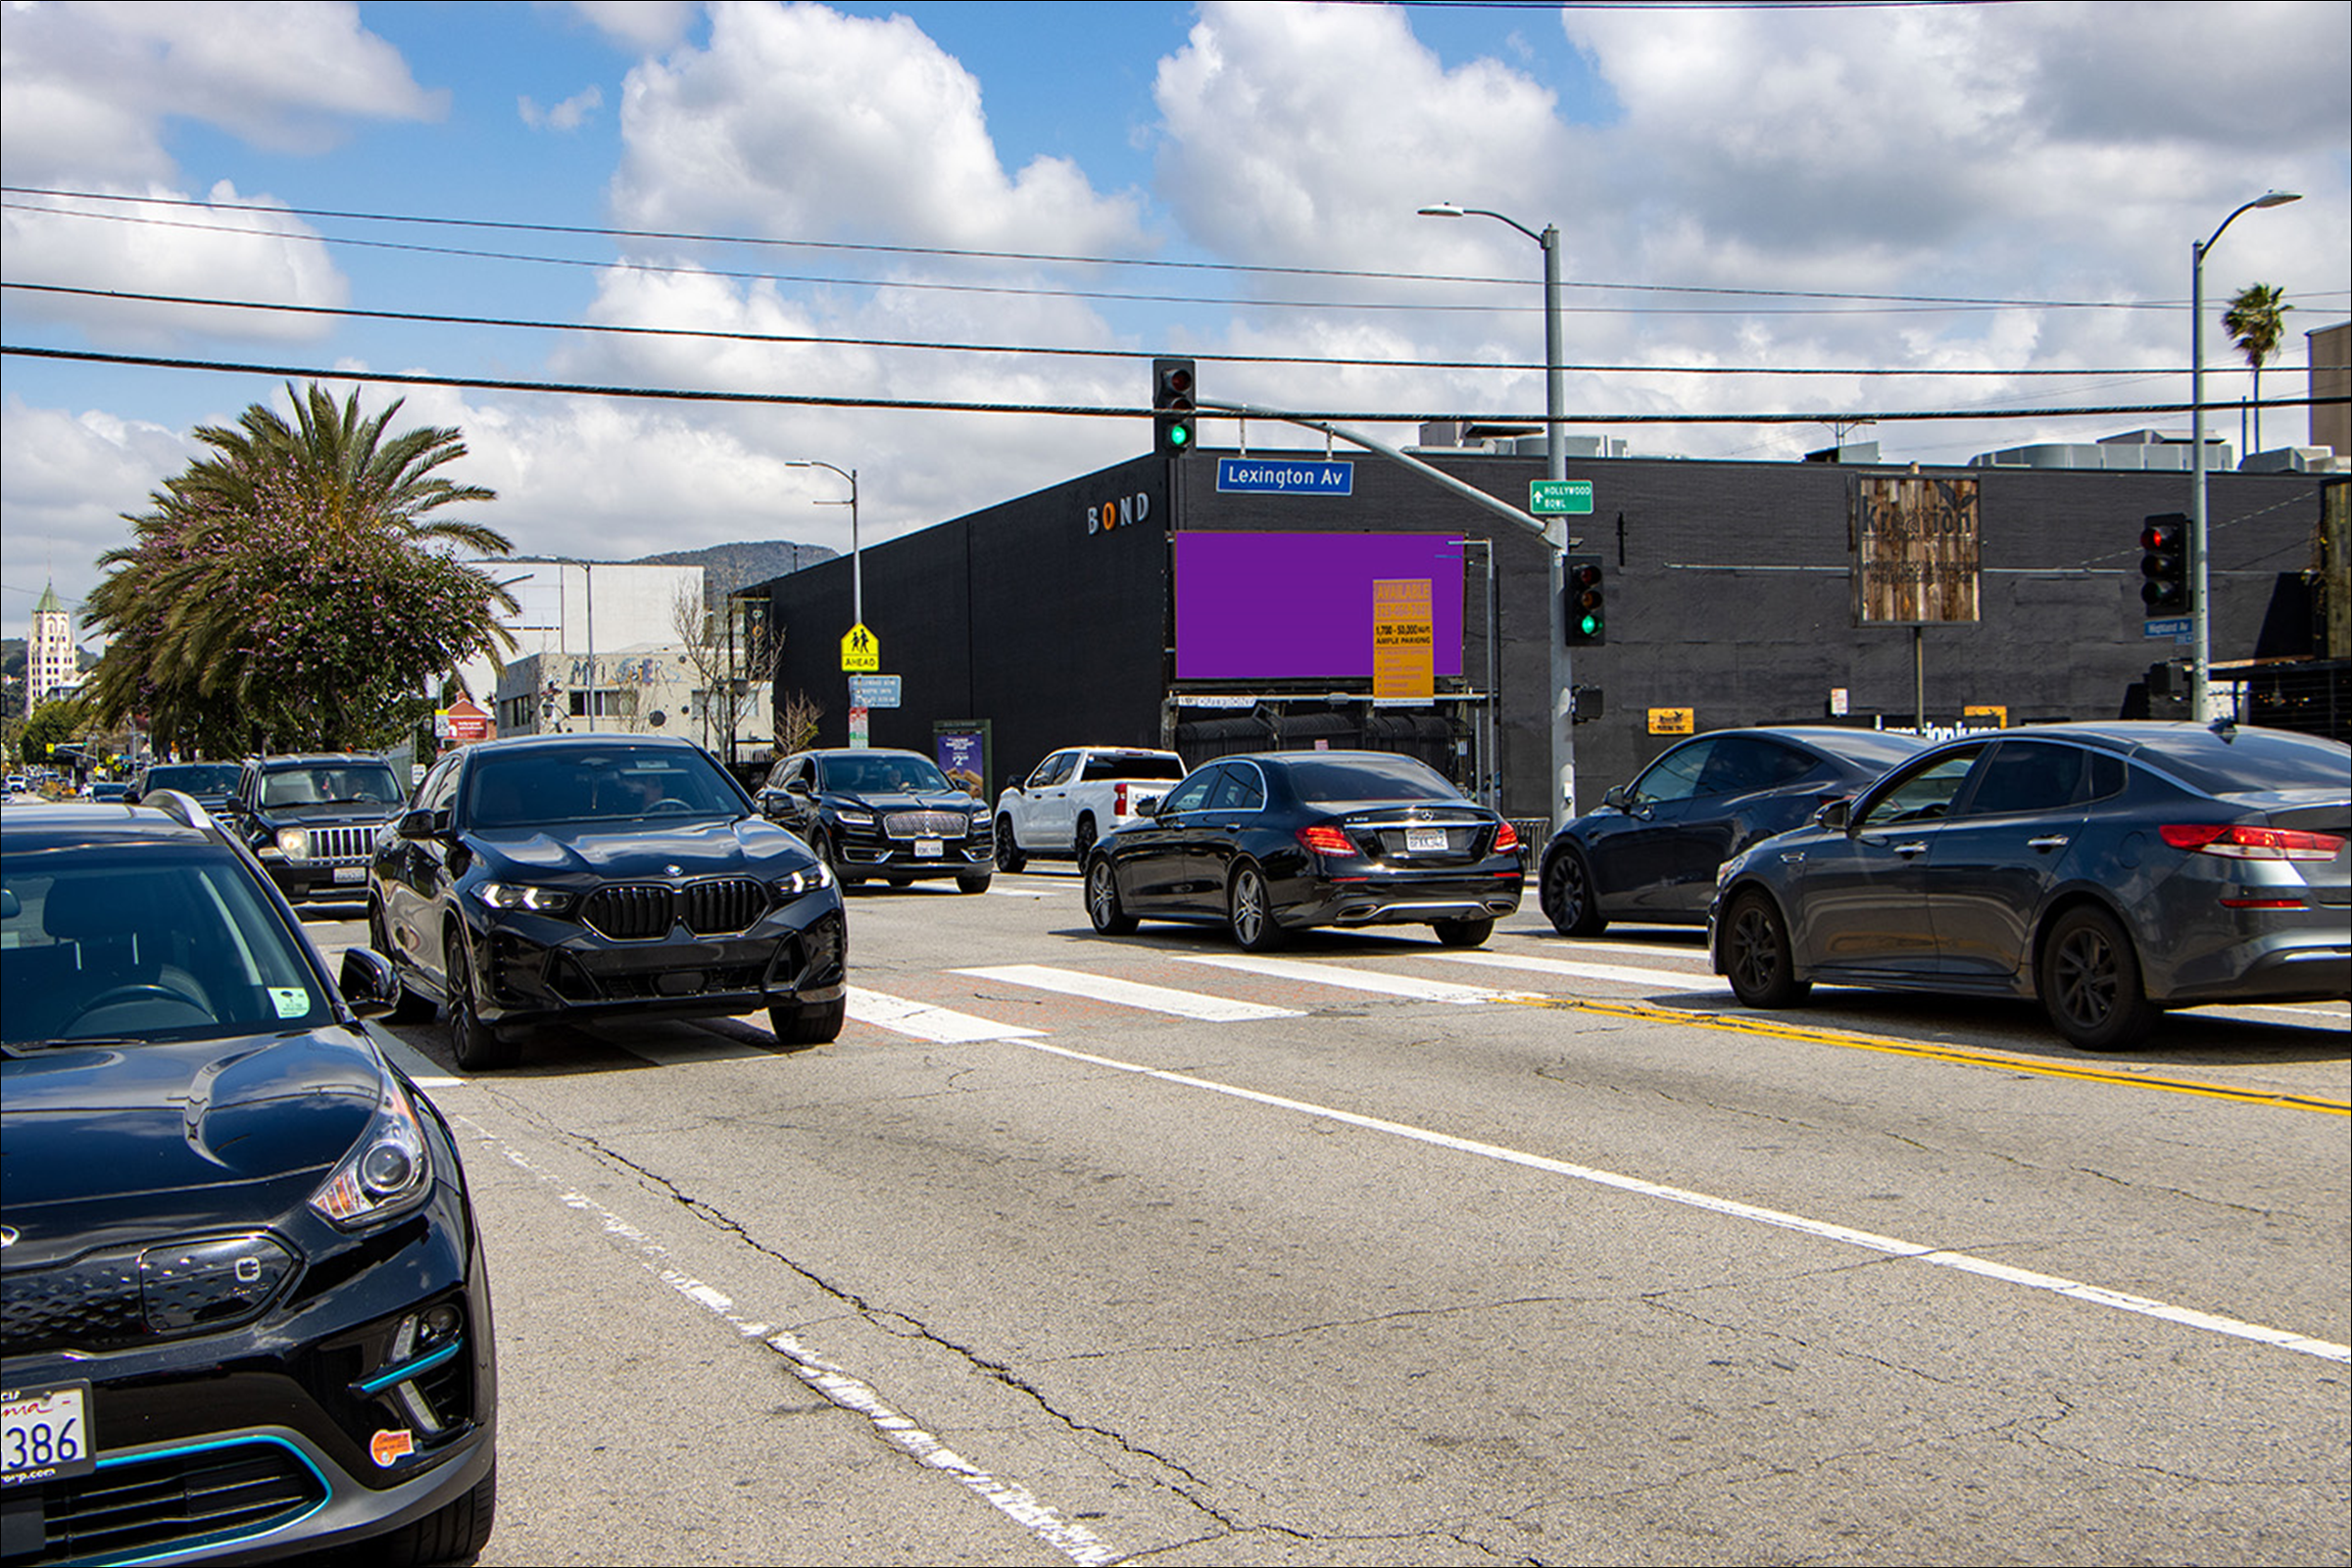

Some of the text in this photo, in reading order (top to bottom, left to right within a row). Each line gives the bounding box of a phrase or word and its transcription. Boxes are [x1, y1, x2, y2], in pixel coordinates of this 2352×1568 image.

[1228, 466, 1343, 489] Lexington Av
[1544, 485, 1592, 496] HOLLYWOOD
[1087, 492, 1150, 536] BOND
[1862, 495, 1972, 535] kreation
[1376, 584, 1430, 601] AVAILABLE
[845, 658, 876, 667] AHEAD
[1, 1417, 77, 1469] 386
[1, 1468, 56, 1484] orp.com
